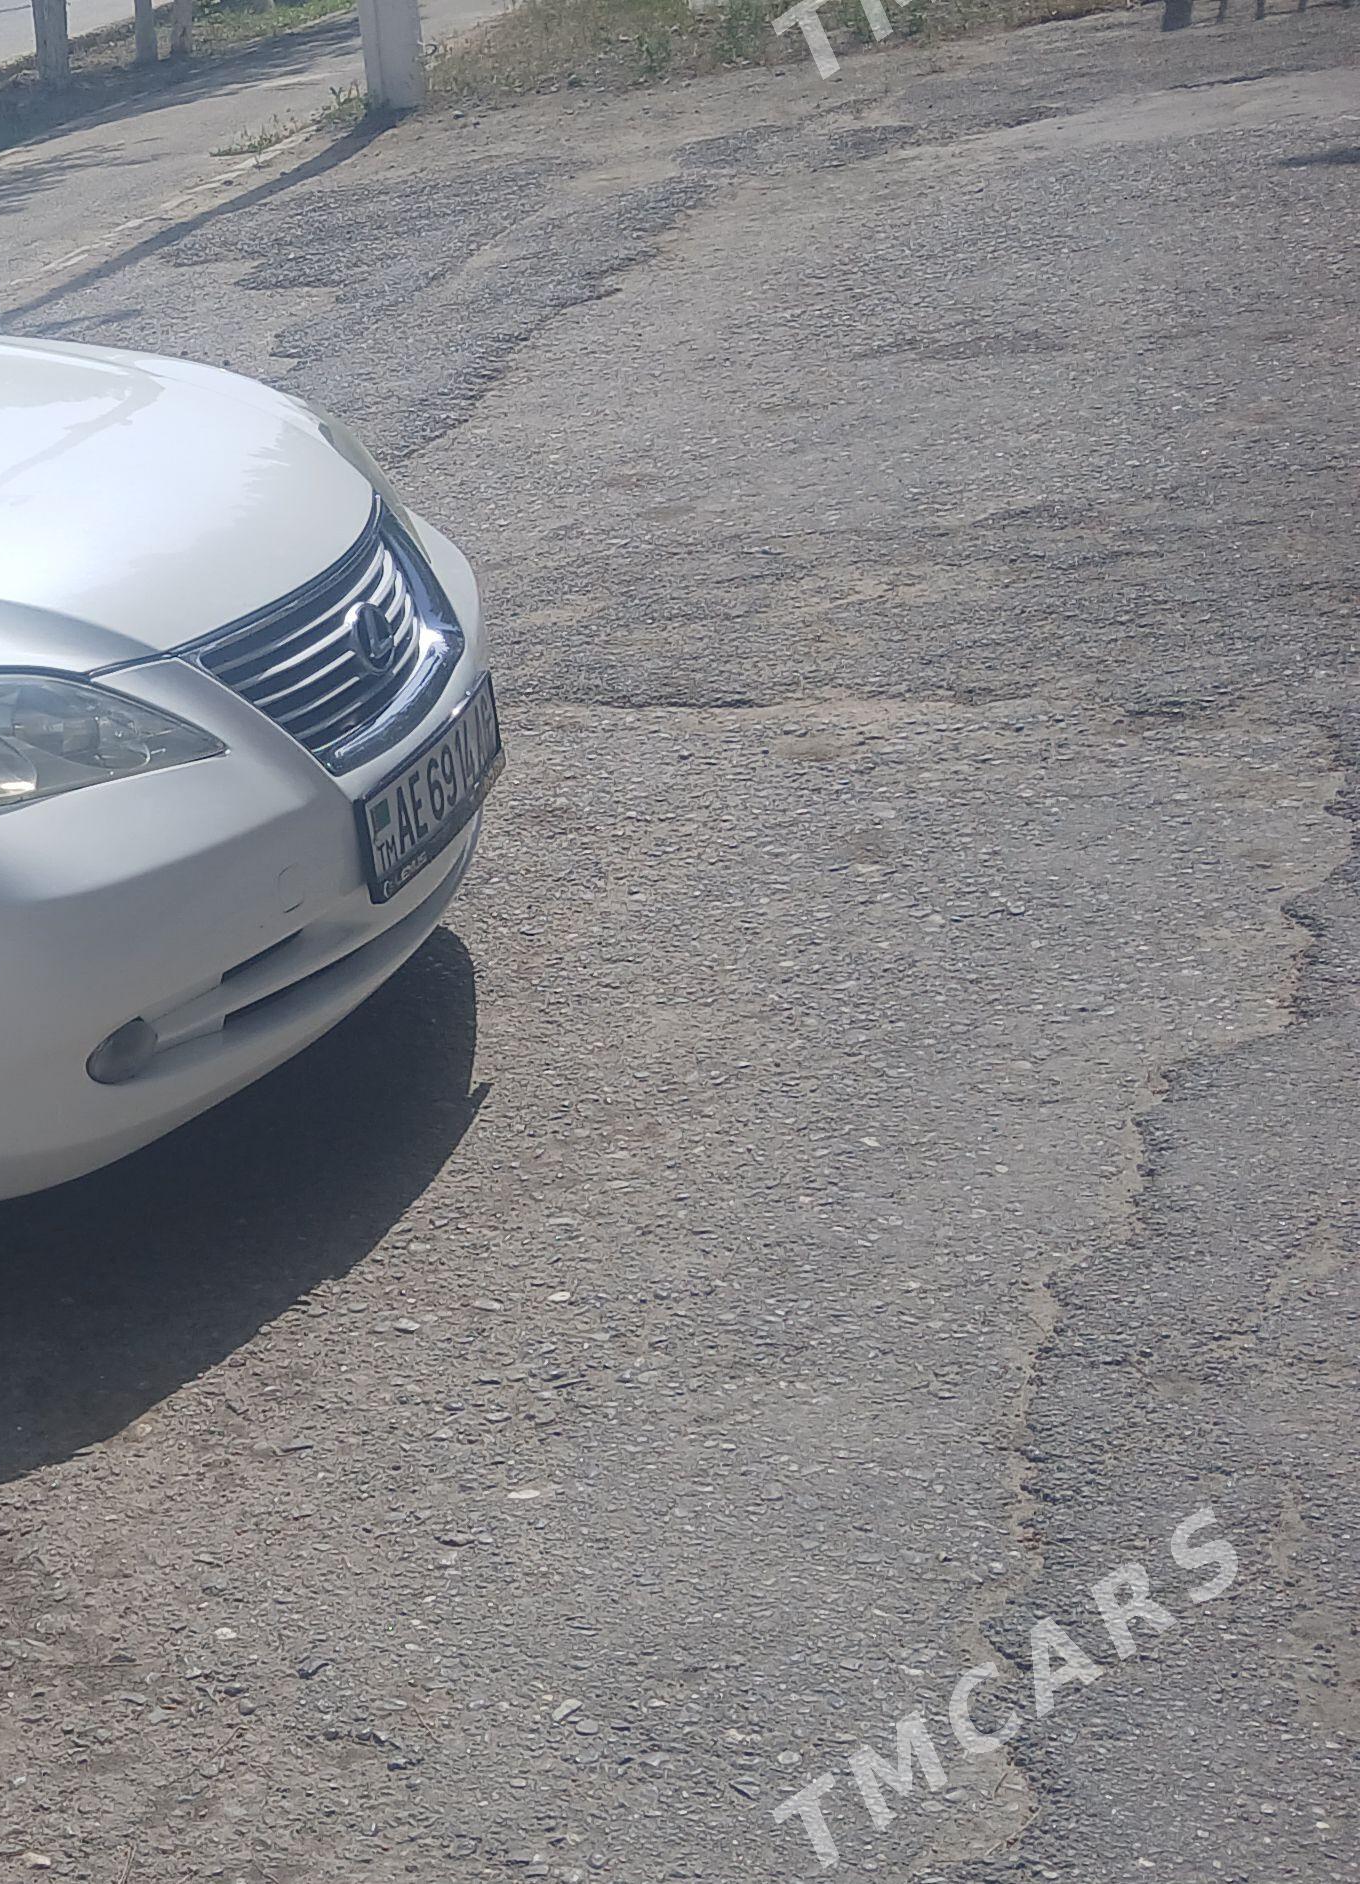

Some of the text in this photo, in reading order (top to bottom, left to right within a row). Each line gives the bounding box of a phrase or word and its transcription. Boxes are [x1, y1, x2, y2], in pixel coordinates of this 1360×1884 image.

[396, 769, 429, 854] AE
[427, 718, 477, 821] 6914
[376, 834, 399, 872] TM
